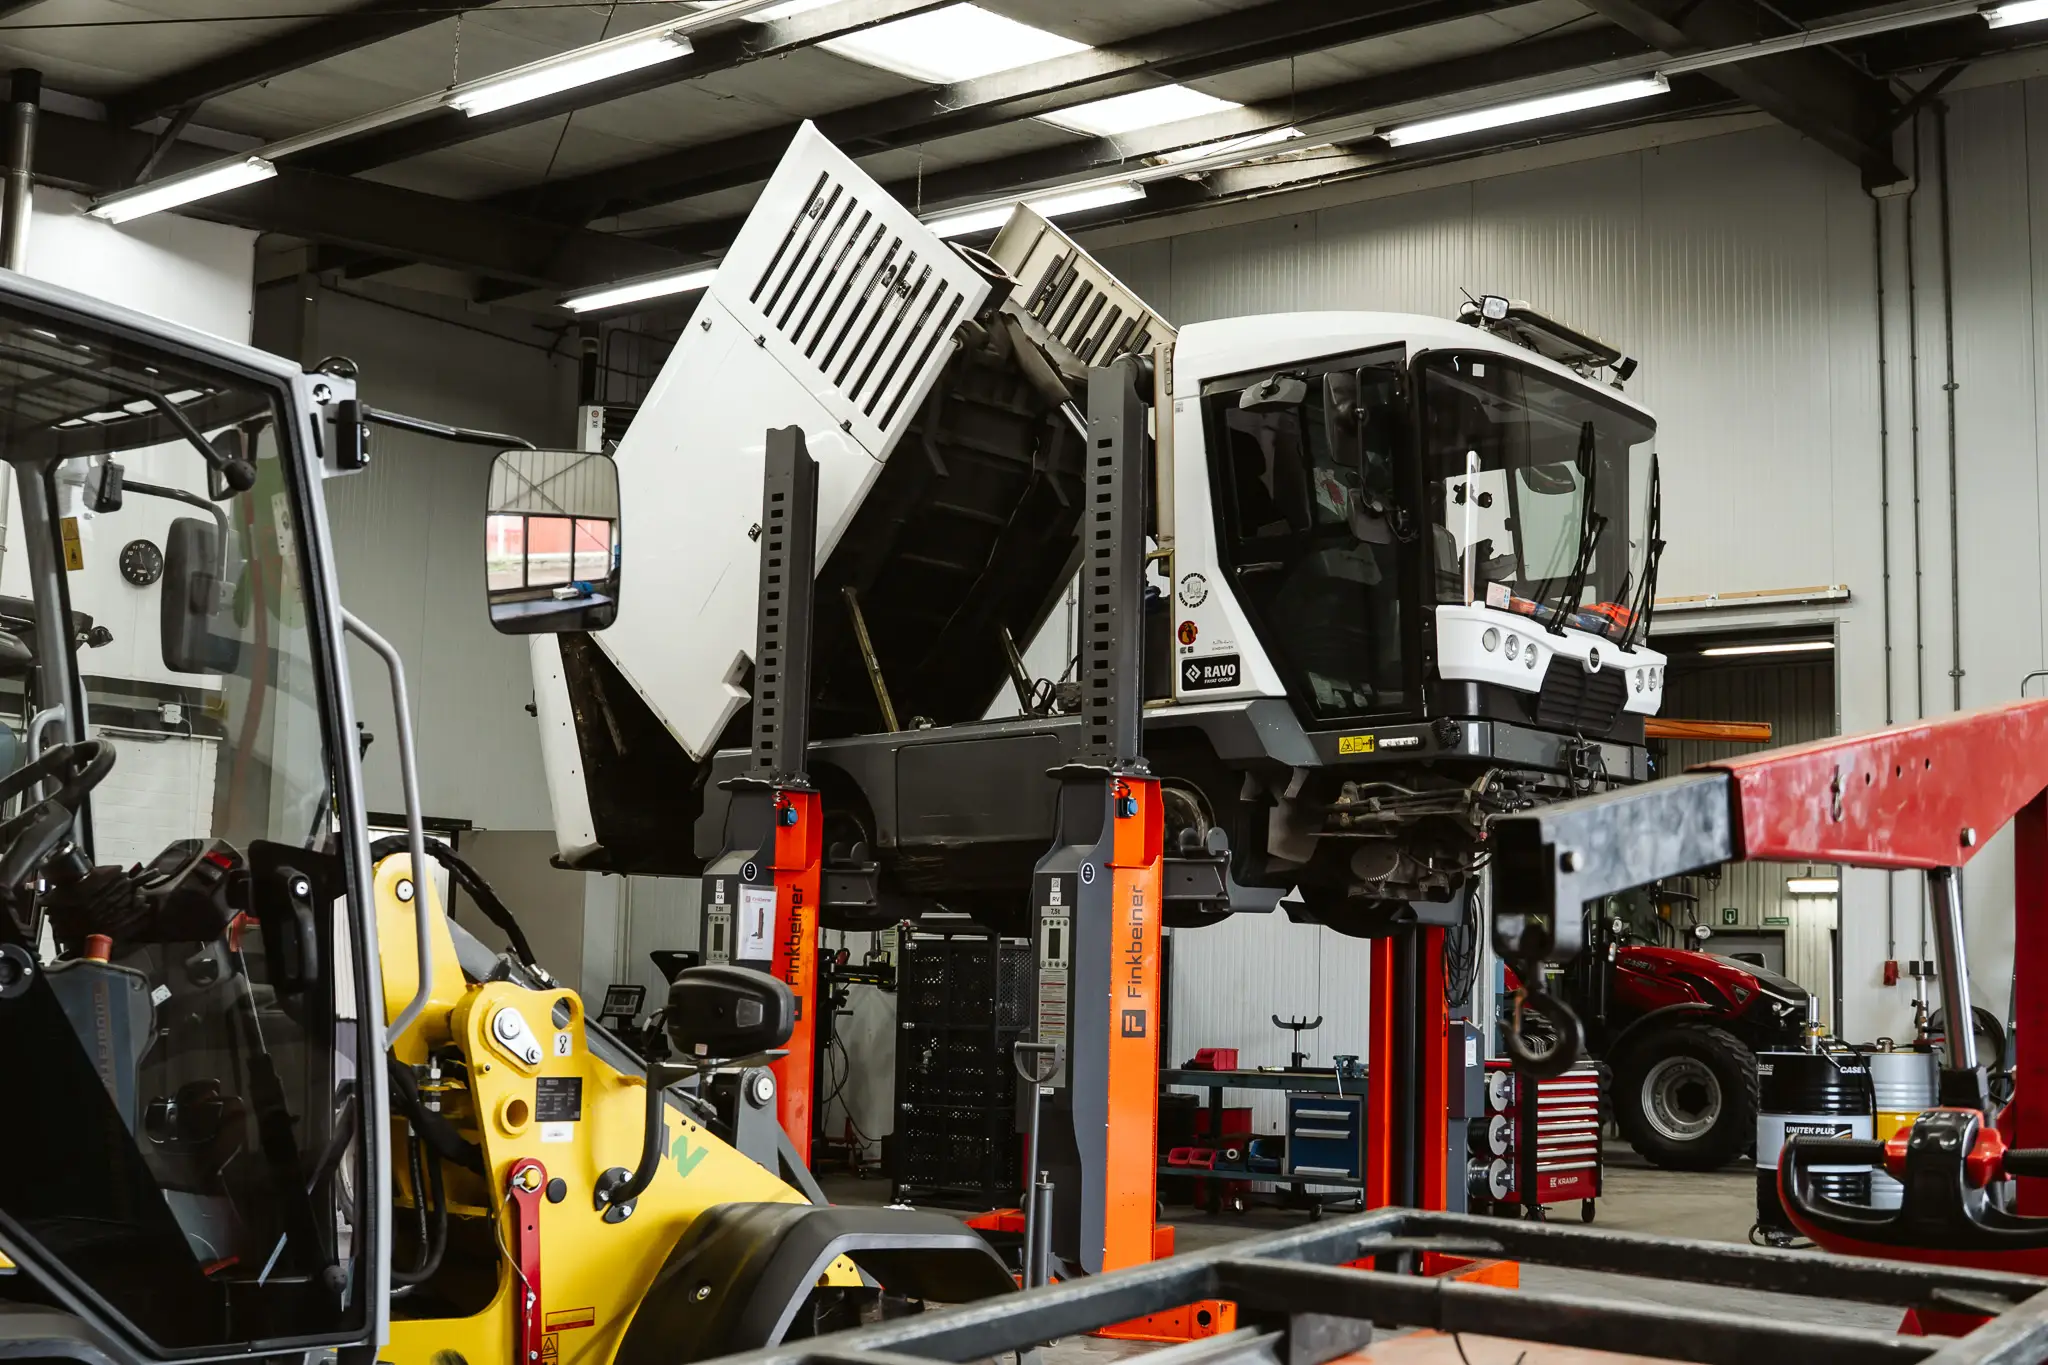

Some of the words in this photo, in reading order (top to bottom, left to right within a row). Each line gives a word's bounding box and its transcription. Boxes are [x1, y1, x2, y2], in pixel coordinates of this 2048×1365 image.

[1204, 664, 1236, 678] RAVO
[784, 883, 803, 986] Finkbeiner
[1125, 884, 1143, 998] Finkbeiner
[1840, 1066, 1861, 1074] CASE
[1786, 1126, 1815, 1135] UNITEK
[1815, 1127, 1836, 1135] PLUS
[1557, 1176, 1578, 1186] KRAMP
